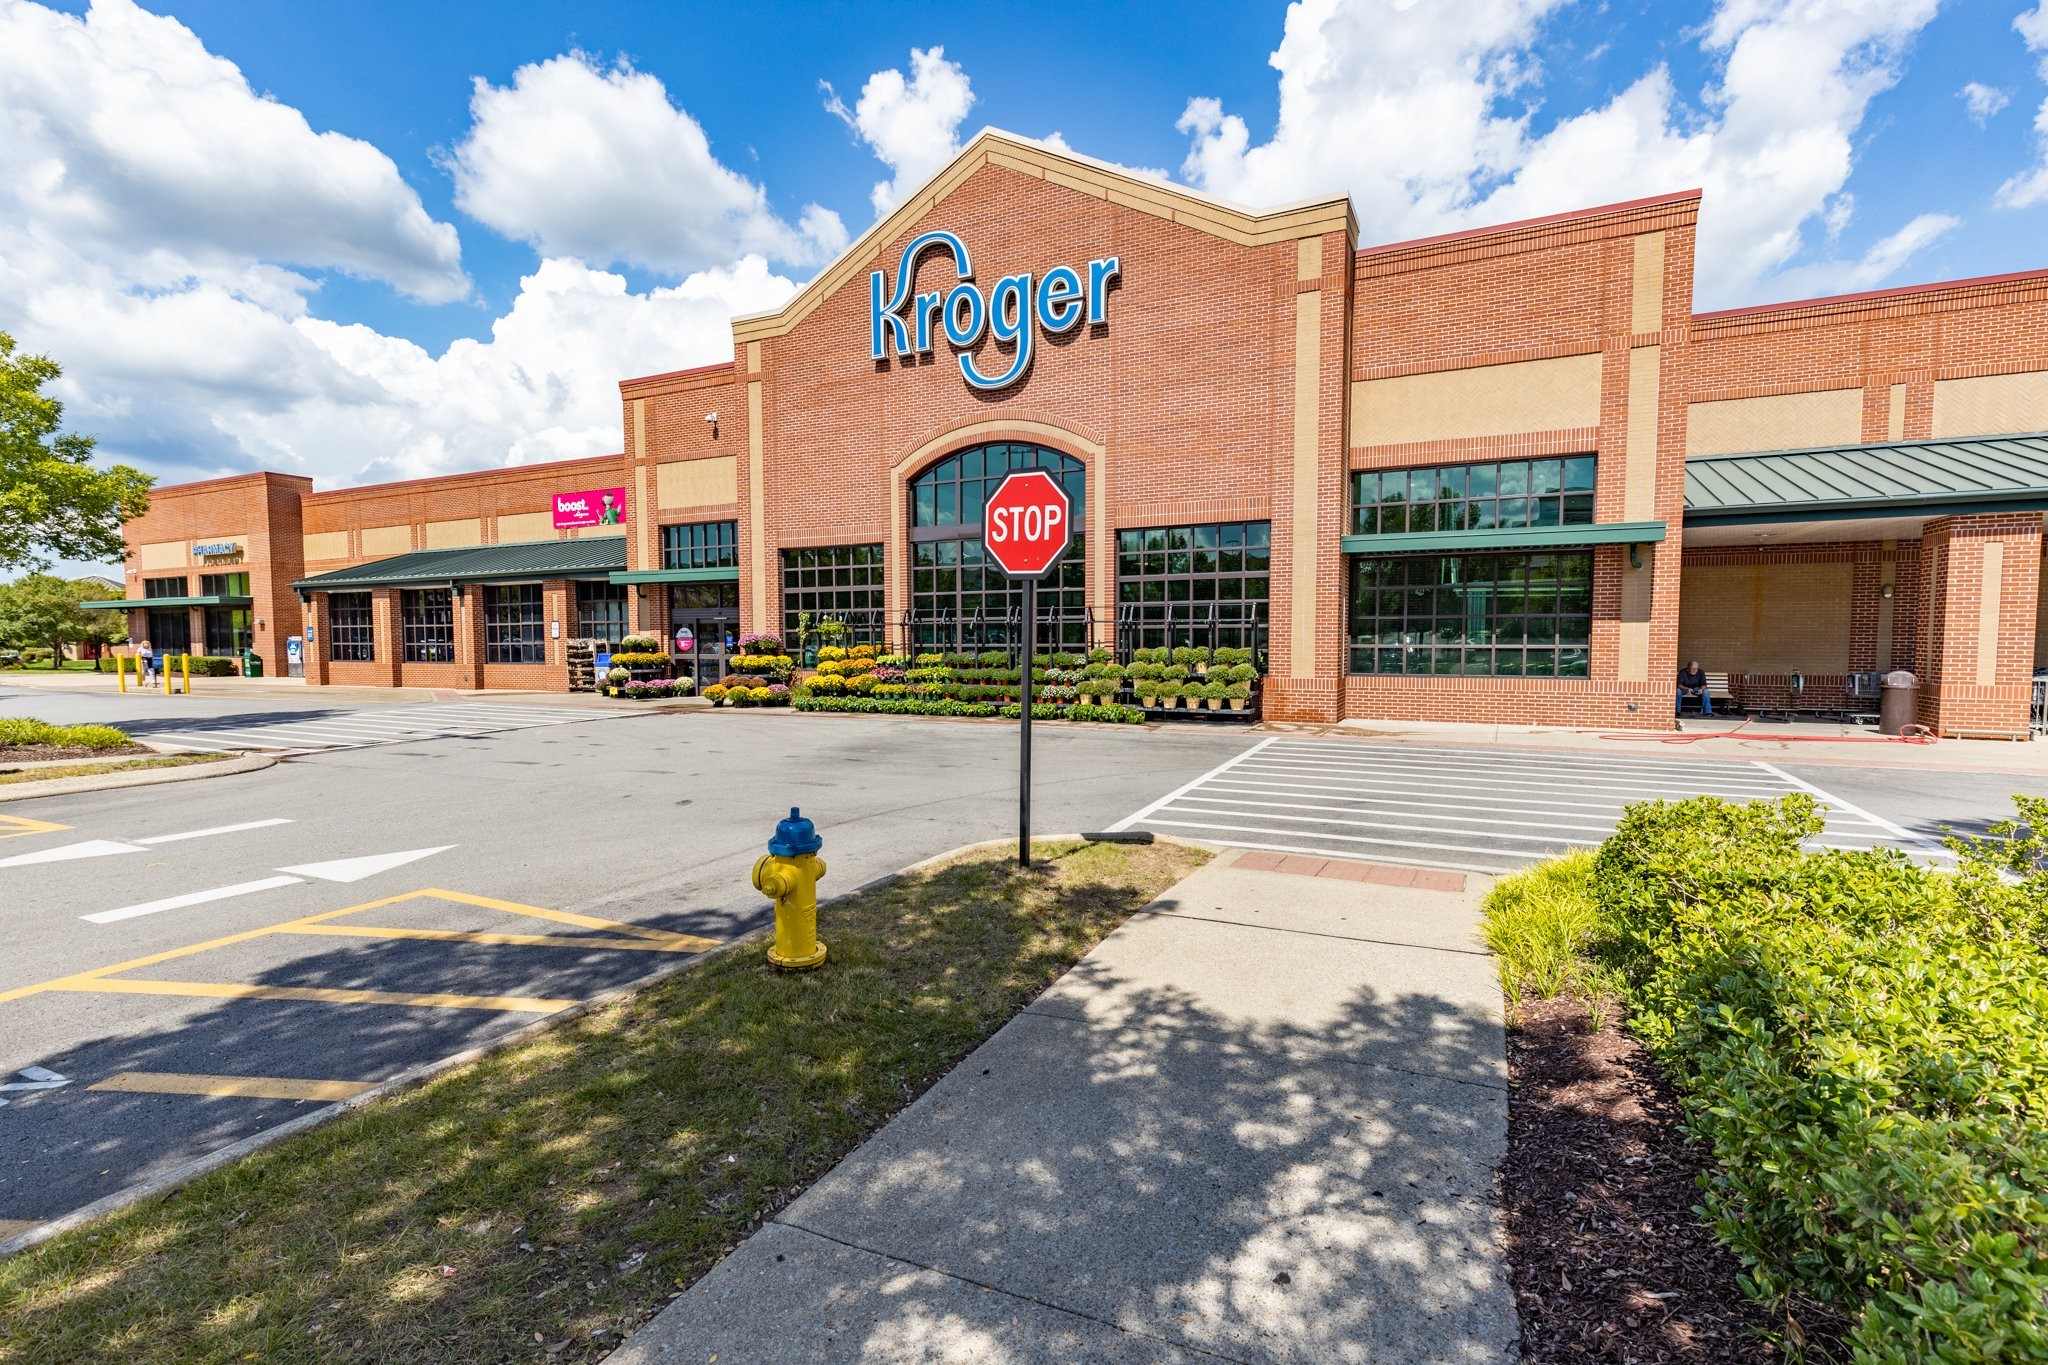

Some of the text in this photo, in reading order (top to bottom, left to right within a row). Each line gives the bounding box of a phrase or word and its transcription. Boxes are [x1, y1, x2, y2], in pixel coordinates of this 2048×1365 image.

[870, 230, 1121, 390] Kroger
[991, 504, 1062, 543] STOP
[192, 542, 237, 556] PHARMACY
